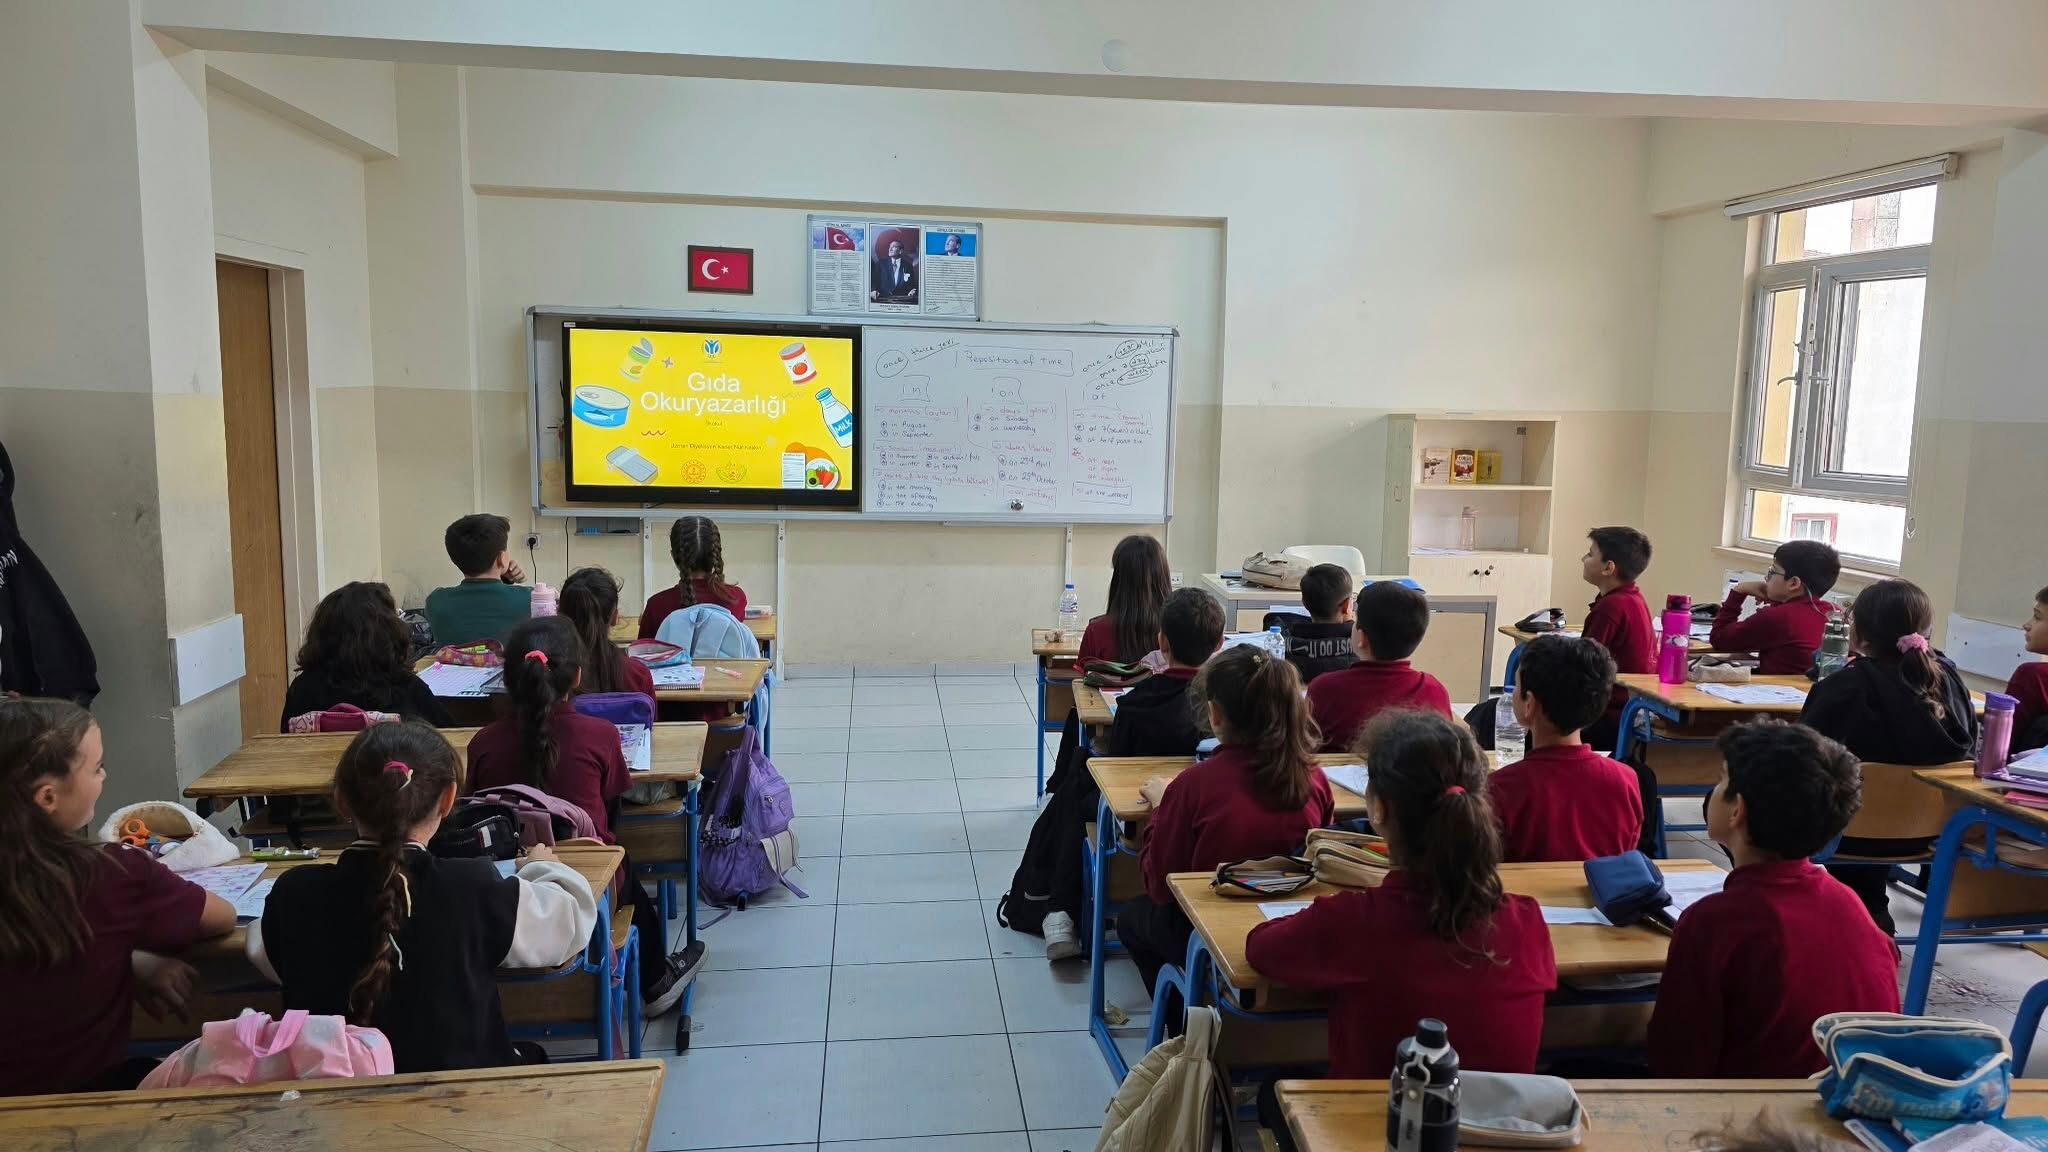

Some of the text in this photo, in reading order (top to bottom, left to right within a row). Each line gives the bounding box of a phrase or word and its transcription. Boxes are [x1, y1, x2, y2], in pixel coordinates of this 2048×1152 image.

[687, 372, 741, 393] Gıda
[640, 391, 787, 419] Okuryazarlığı
[1308, 640, 1317, 658] IT
[1320, 640, 1333, 656] DO
